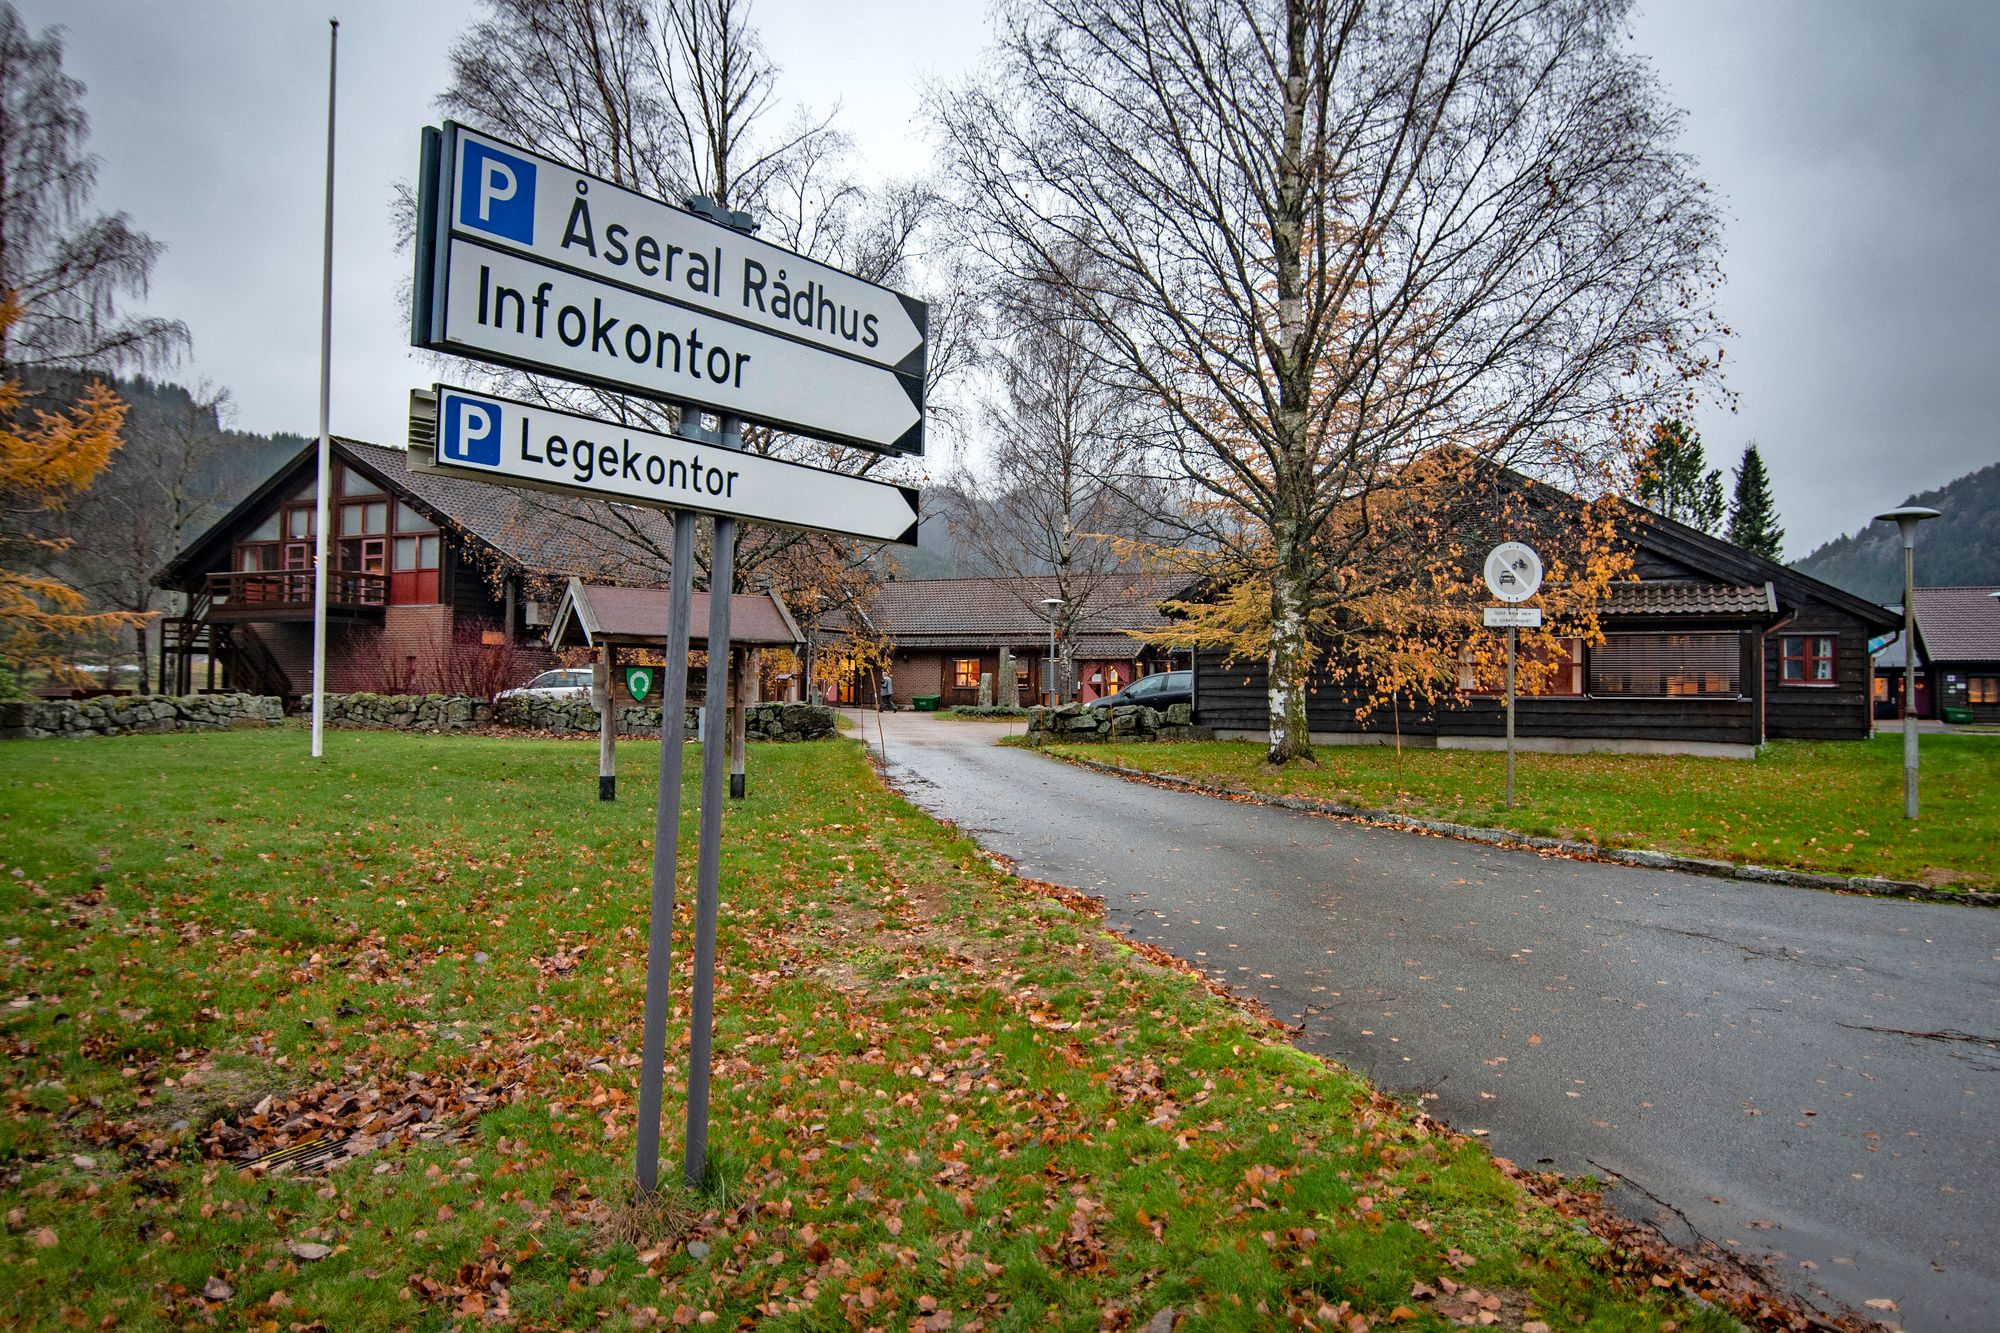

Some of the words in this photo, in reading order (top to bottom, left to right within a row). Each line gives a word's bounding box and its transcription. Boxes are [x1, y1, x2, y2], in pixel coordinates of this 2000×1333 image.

[479, 156, 518, 221] P
[561, 178, 722, 298] Åseral
[742, 257, 880, 349] Rådhus
[477, 264, 752, 389] Infokontor
[458, 403, 492, 456] P
[520, 416, 739, 498] Legekontor
